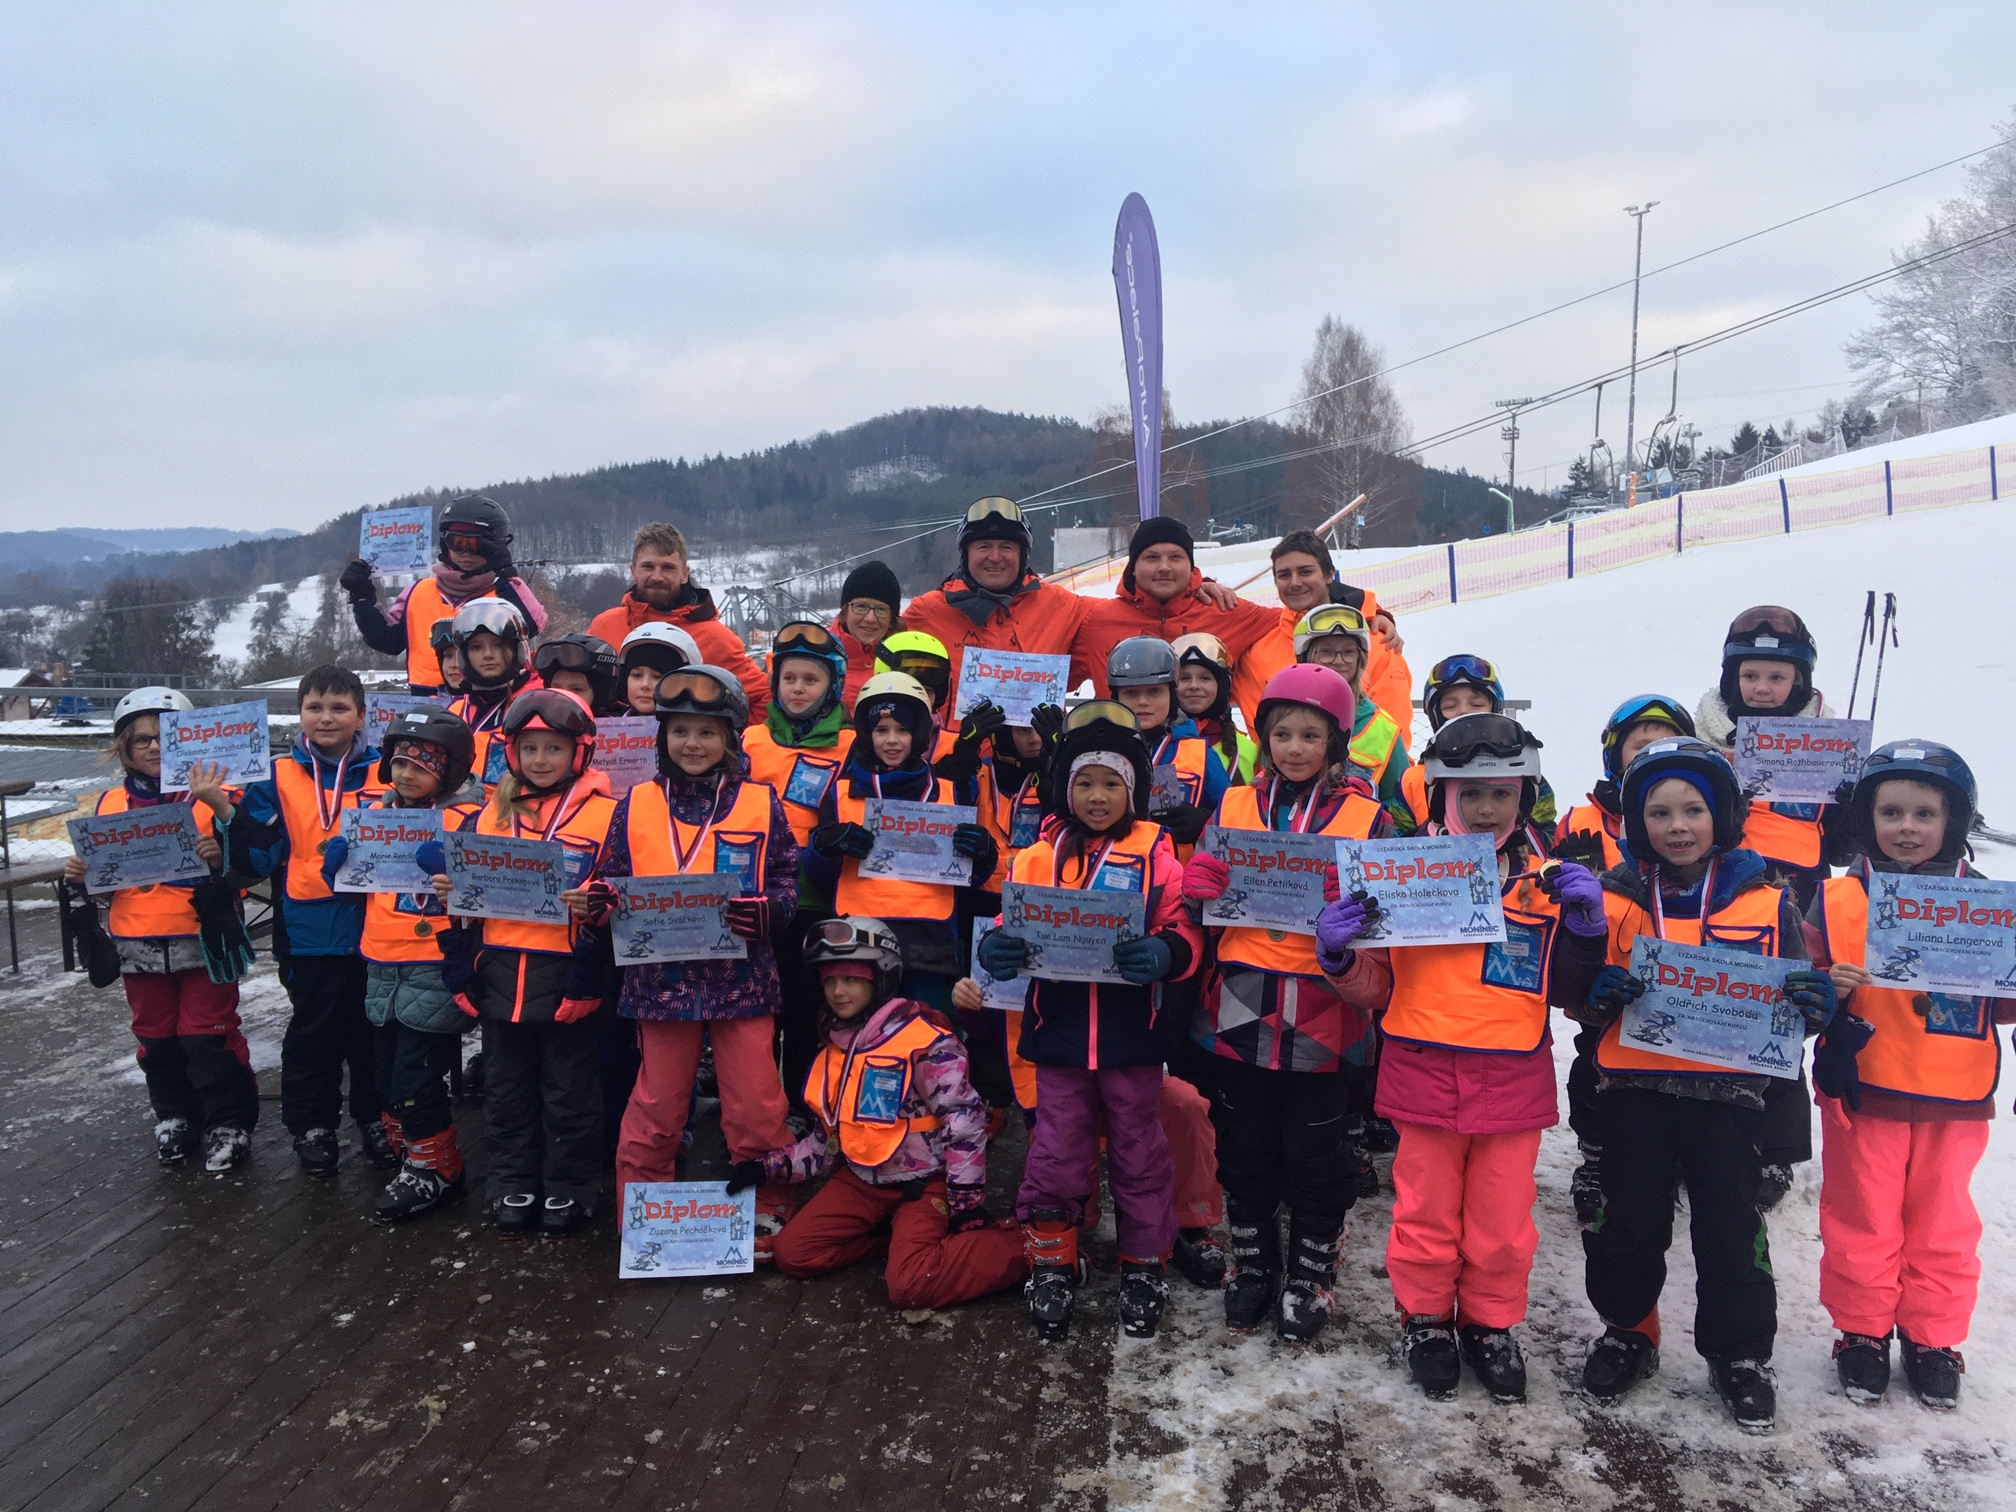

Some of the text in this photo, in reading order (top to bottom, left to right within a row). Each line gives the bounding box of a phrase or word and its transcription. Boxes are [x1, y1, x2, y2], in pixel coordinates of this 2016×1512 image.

[370, 521, 421, 539] Diplom
[979, 663, 1054, 684] Diplom
[178, 721, 255, 744] Diplom
[597, 732, 657, 754] iplom
[1757, 733, 1852, 754] Diplom
[1756, 758, 1784, 766] Simona
[90, 822, 180, 846] Diplom
[360, 824, 433, 846] Diplom
[882, 815, 958, 837] Diplom
[464, 850, 549, 873] Diplom
[1228, 848, 1330, 876] Diplom
[1361, 857, 1474, 886] Diplom
[472, 873, 540, 887] Barbora Prokopová
[1244, 876, 1266, 886] Ellen
[629, 891, 722, 914] Diplom
[1896, 897, 2016, 928] Diplom
[643, 916, 666, 926] Sofie
[1024, 903, 1124, 929] Diplom
[1036, 930, 1106, 946] Tue Lam Nguyen
[1460, 924, 1499, 934] MONÍNEC
[1908, 932, 2004, 948] Liliana Lengerová
[1656, 961, 1783, 1005] Diplom
[1667, 996, 1758, 1020] Oldřich Svoboda
[1748, 1054, 1792, 1068] MONÍNEC
[645, 1200, 737, 1224] Diplom
[649, 1225, 726, 1236] Zuzana Pecháčková
